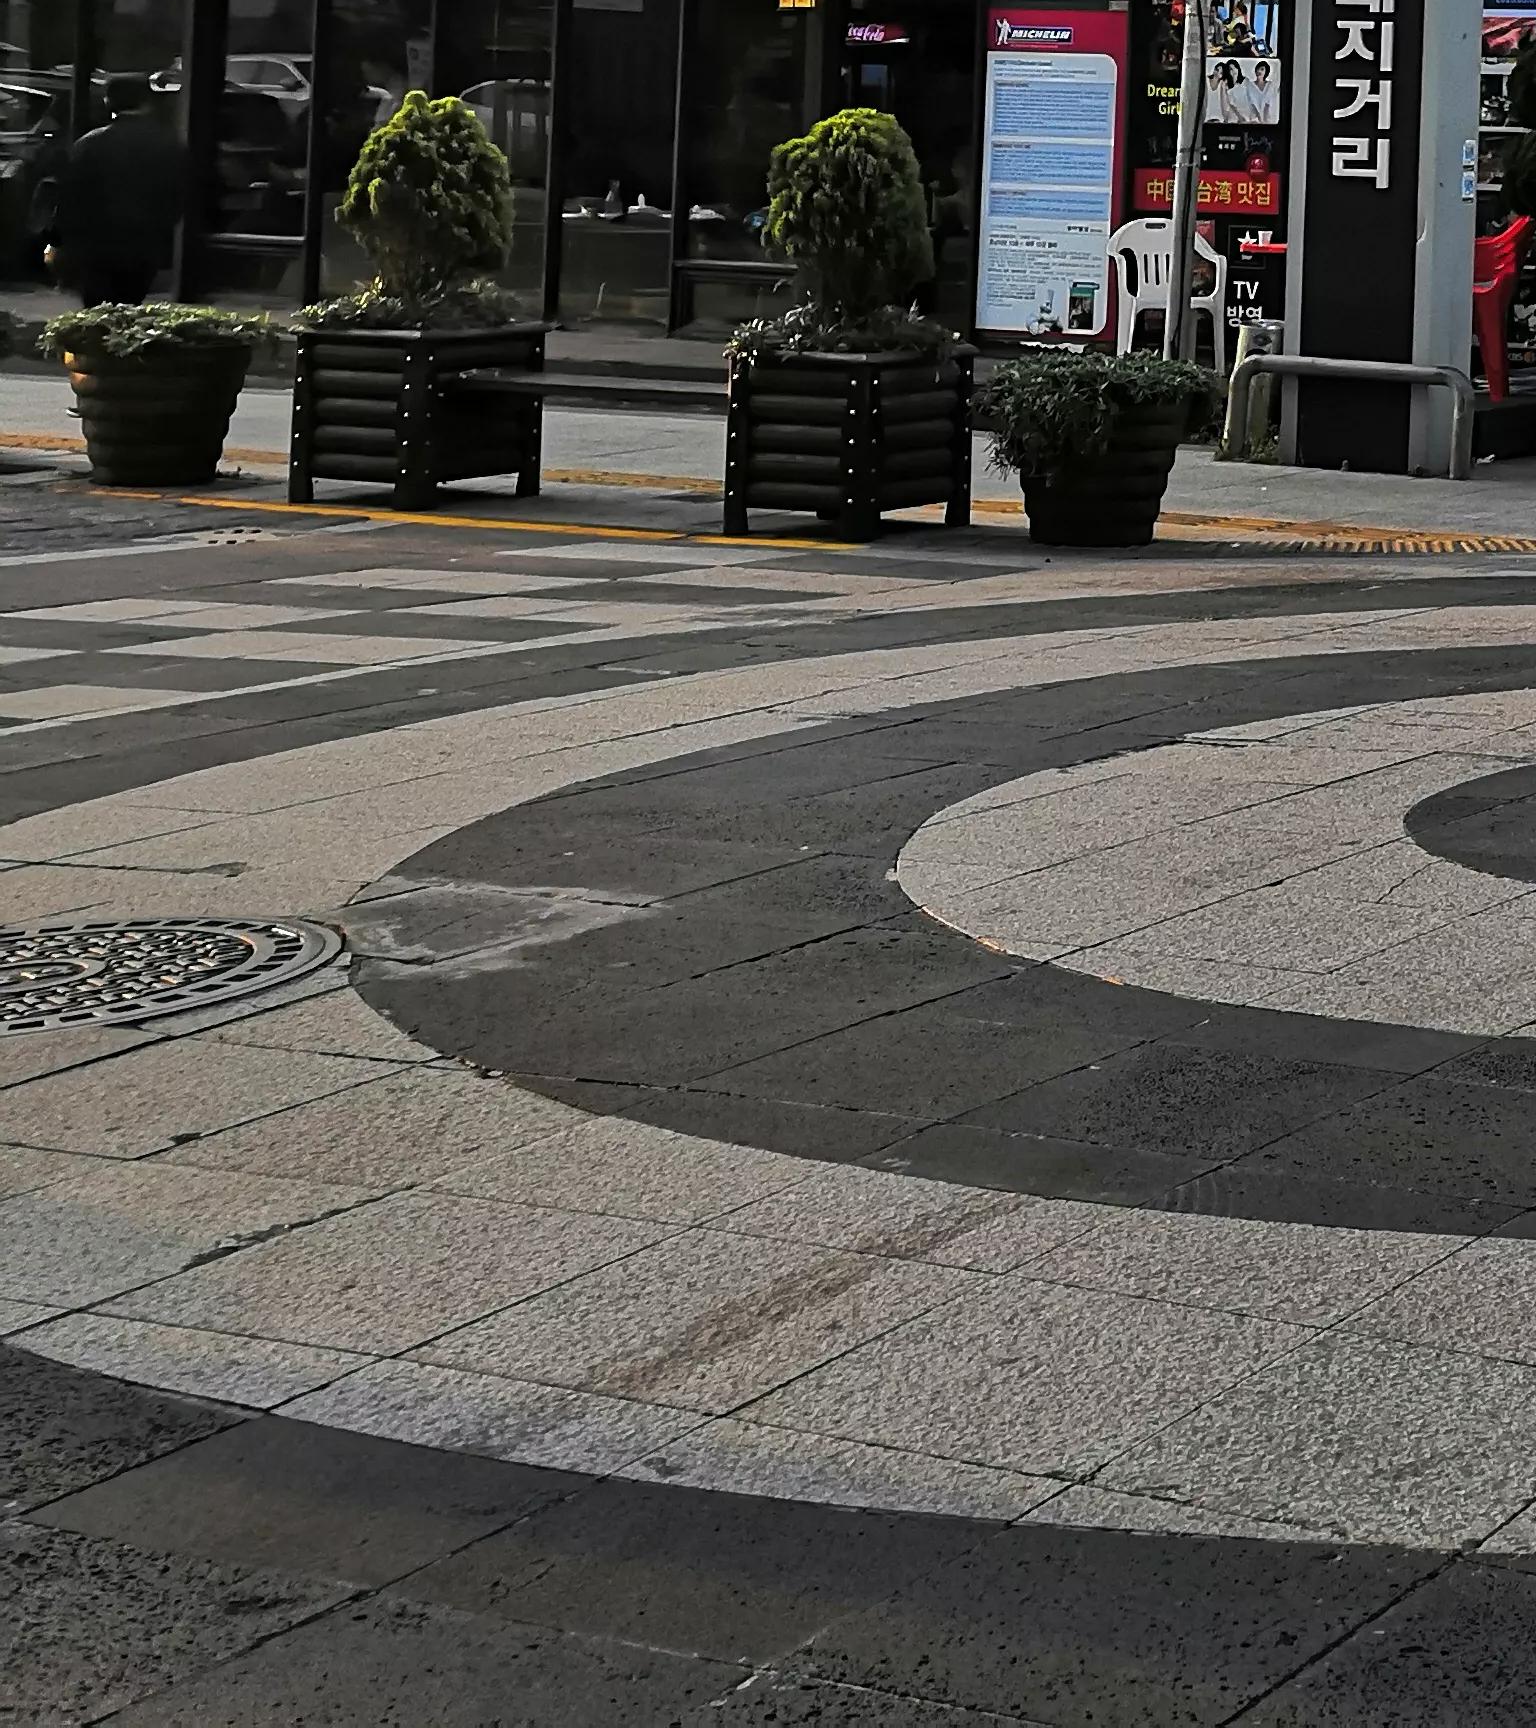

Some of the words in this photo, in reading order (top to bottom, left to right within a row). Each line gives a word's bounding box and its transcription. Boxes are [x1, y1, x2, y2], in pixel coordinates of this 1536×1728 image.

[1011, 29, 1071, 40] MICHELIN
[1237, 180, 1271, 206] 맛집
[1233, 280, 1260, 300] TV
